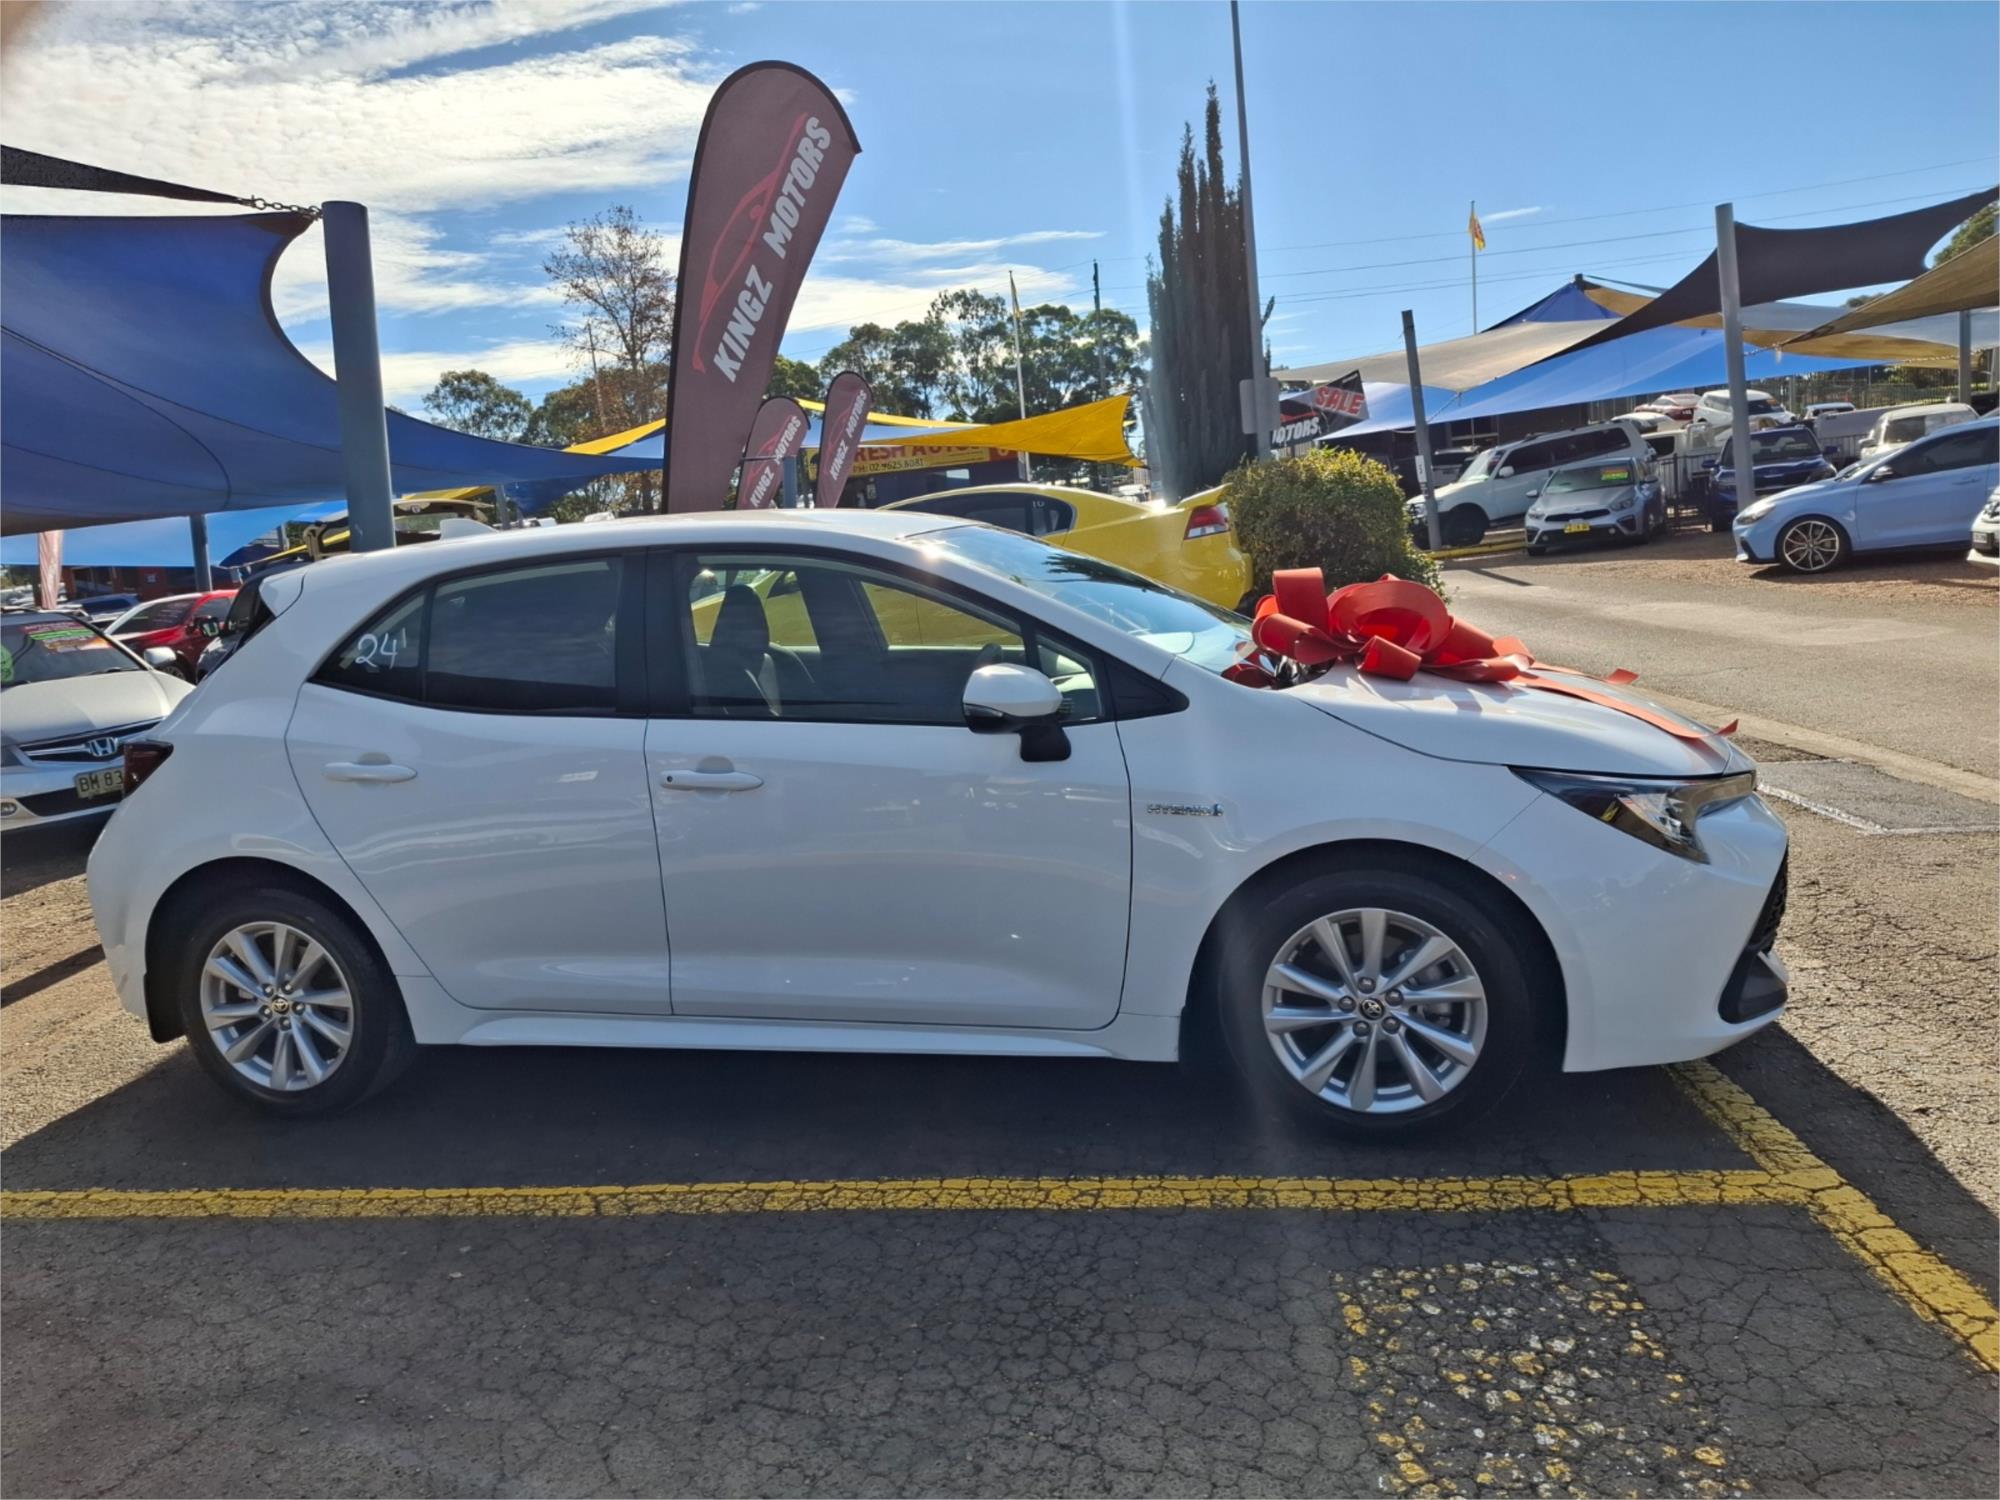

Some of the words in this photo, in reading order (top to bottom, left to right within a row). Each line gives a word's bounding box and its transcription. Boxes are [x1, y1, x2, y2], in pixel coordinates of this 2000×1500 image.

[713, 264, 773, 382] KINGZ
[763, 116, 832, 259] MOTORS
[829, 439, 848, 480] KINGZ
[845, 389, 867, 438] MOTORS
[1315, 386, 1364, 415] SALE
[750, 466, 775, 507] KINGZ
[773, 415, 801, 464] MOTORS
[854, 446, 905, 462] RESH
